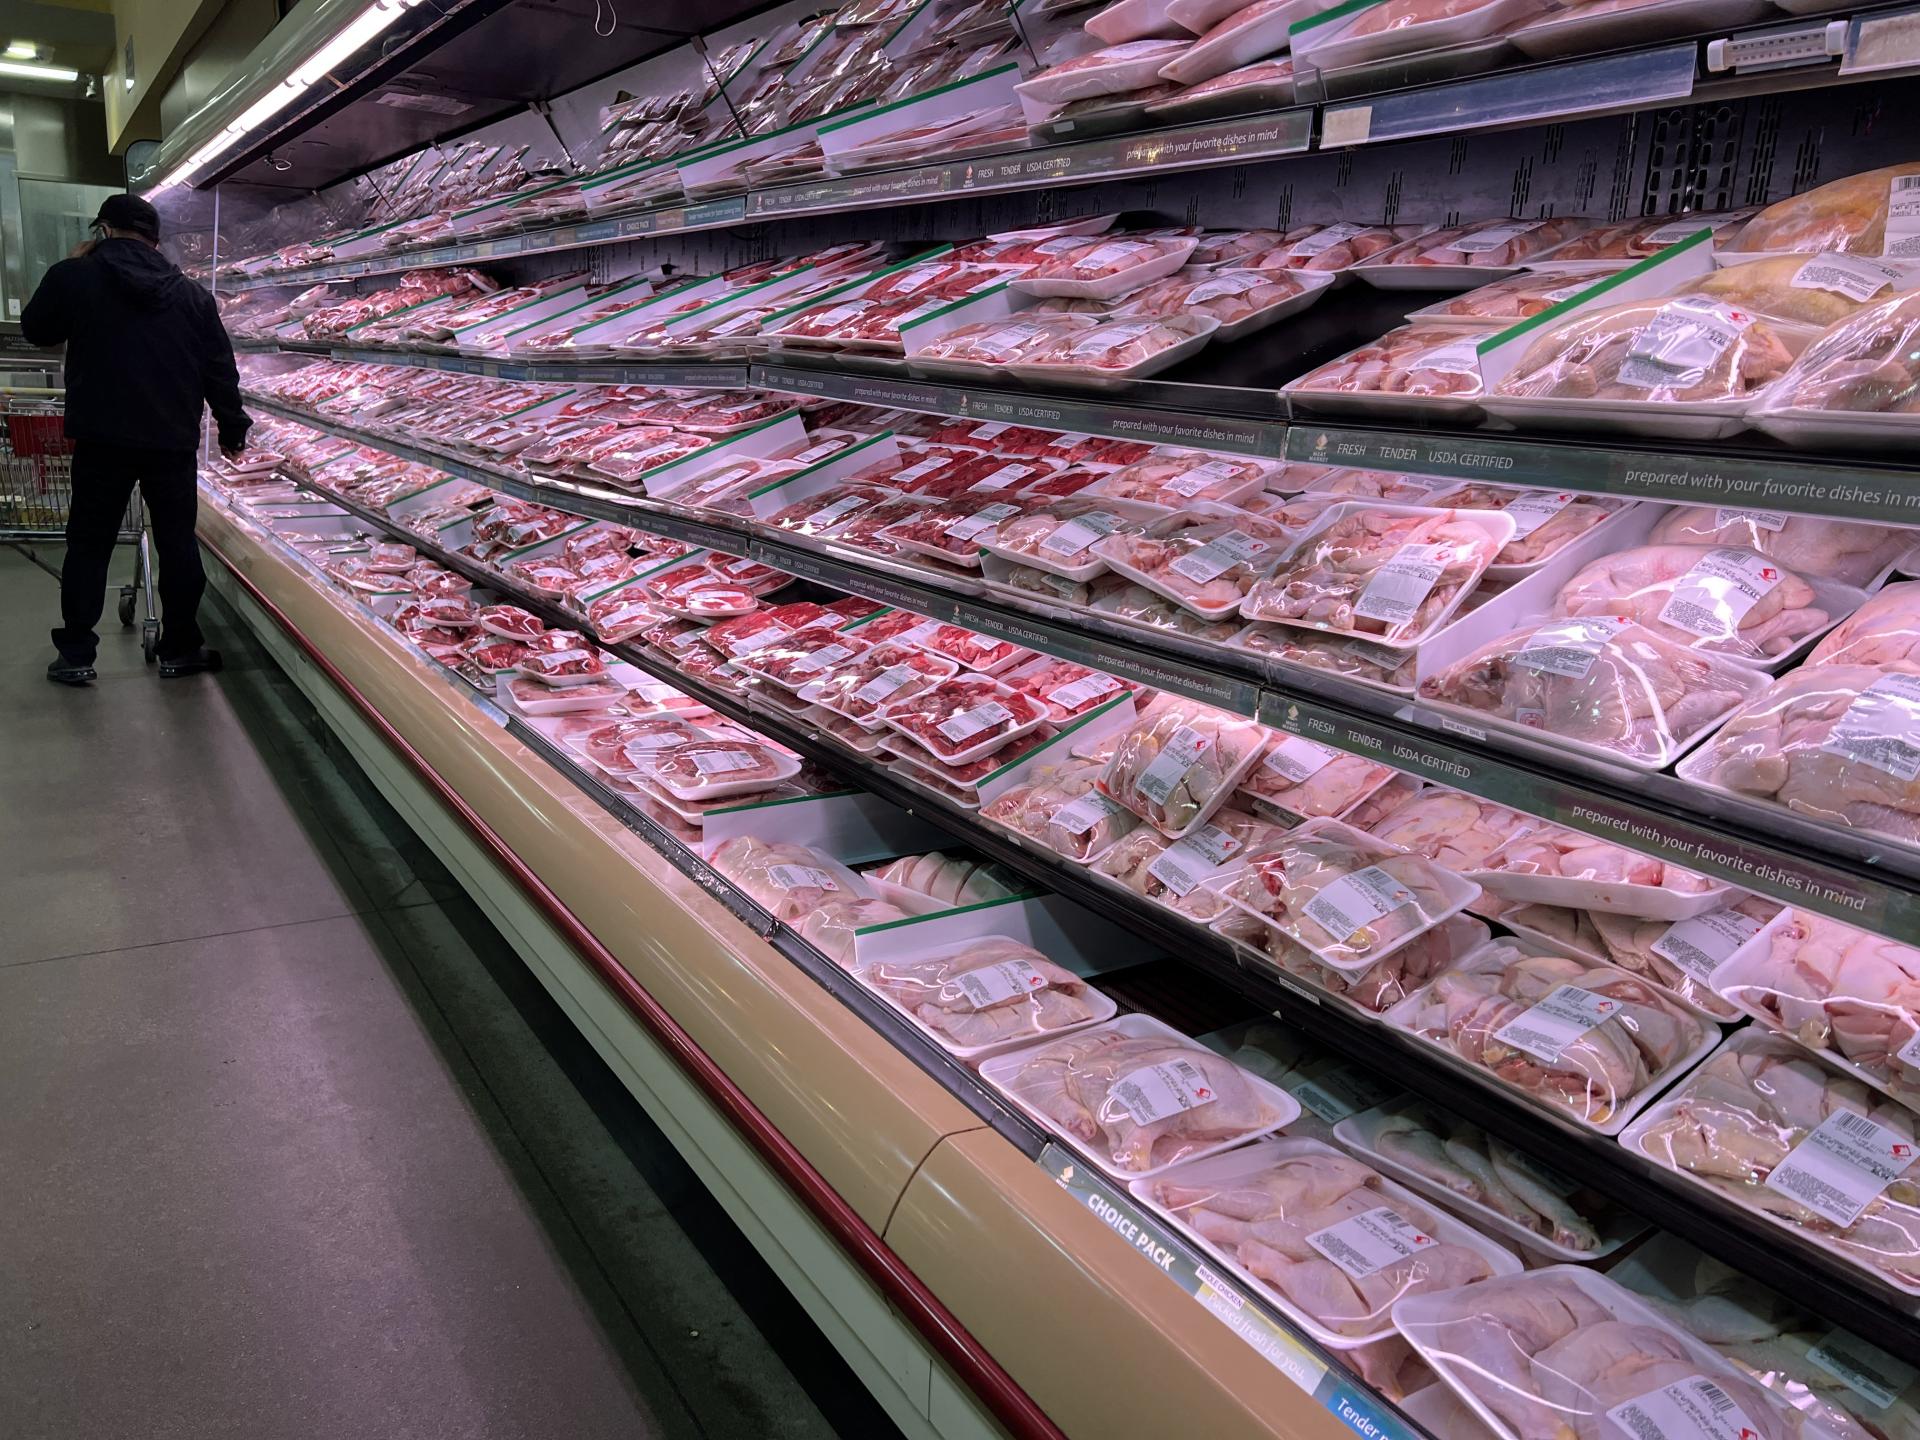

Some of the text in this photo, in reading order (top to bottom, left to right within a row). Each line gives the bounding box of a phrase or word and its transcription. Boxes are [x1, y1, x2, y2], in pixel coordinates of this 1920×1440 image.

[1174, 141, 1191, 155] your
[1192, 138, 1221, 152] favorite
[1223, 134, 1247, 146] dishes
[1248, 133, 1255, 141] in
[1257, 128, 1278, 140] mind
[978, 168, 994, 178] FRESH
[1001, 164, 1021, 175] TENDER
[1027, 161, 1042, 172] USDA
[972, 401, 1061, 420] FRESH TENDER USDA CERTIFIED
[1112, 418, 1254, 444] prepared with your favorite dishes in mind
[1337, 443, 1514, 469] FRESH TENDER USDA CERTIFIED
[1625, 469, 1688, 487] prepared
[1690, 472, 1722, 488] with
[1724, 479, 1760, 493] your
[1763, 478, 1826, 498] favorite
[1829, 484, 1880, 504] dishes
[1885, 489, 1901, 506] in
[964, 612, 979, 623] FRESH
[984, 618, 1003, 631] TENDER
[1008, 625, 1022, 637] USDA
[1022, 628, 1048, 644] CERTIFIED
[1097, 653, 1231, 700] prepared with your favorite dishes in mind
[1308, 717, 1471, 779] FRESH TENDER USDA CERTIFIED
[1572, 804, 1867, 912] prepared with your favorite dishes in mind
[1088, 1194, 1176, 1272] CHOICE PACK
[1199, 1267, 1242, 1308] WHOLE CHICKEN
[1208, 1292, 1305, 1379] Packed fresh for you.
[1337, 1397, 1380, 1440] Tender
